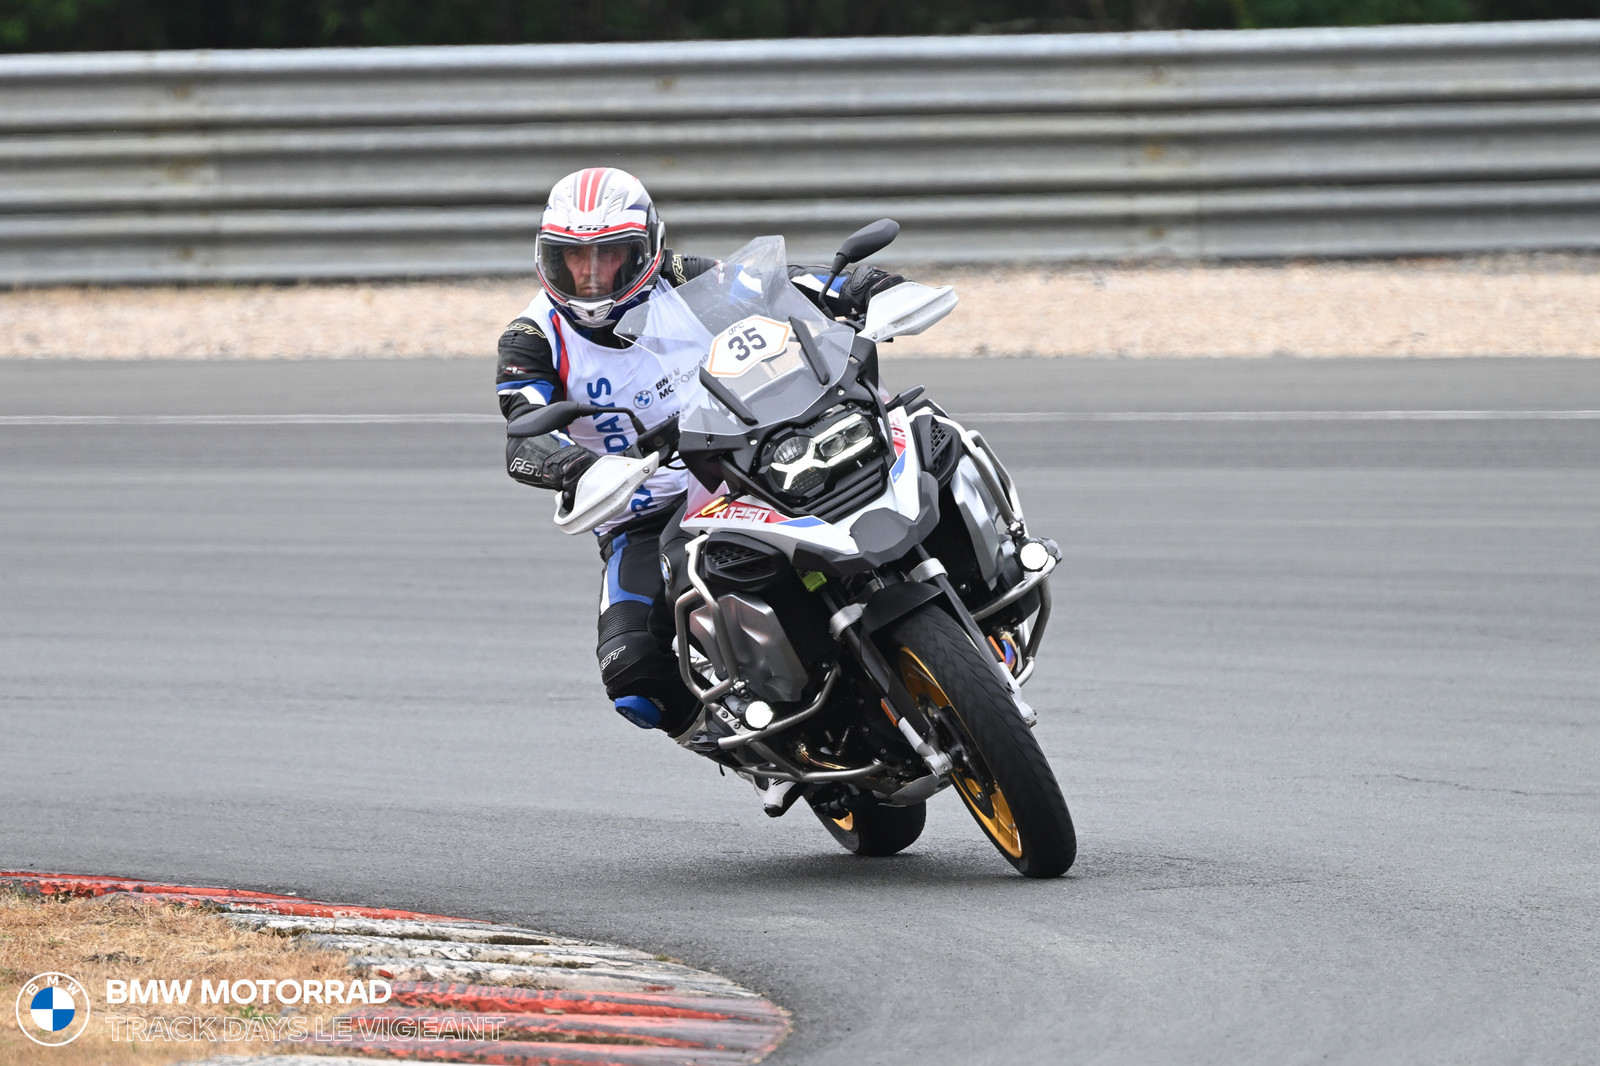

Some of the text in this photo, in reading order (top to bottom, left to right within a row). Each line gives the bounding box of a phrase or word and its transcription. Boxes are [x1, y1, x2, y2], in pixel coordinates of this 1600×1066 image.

[565, 224, 609, 232] LS2
[727, 326, 767, 361] 35
[586, 377, 629, 453] DAYS
